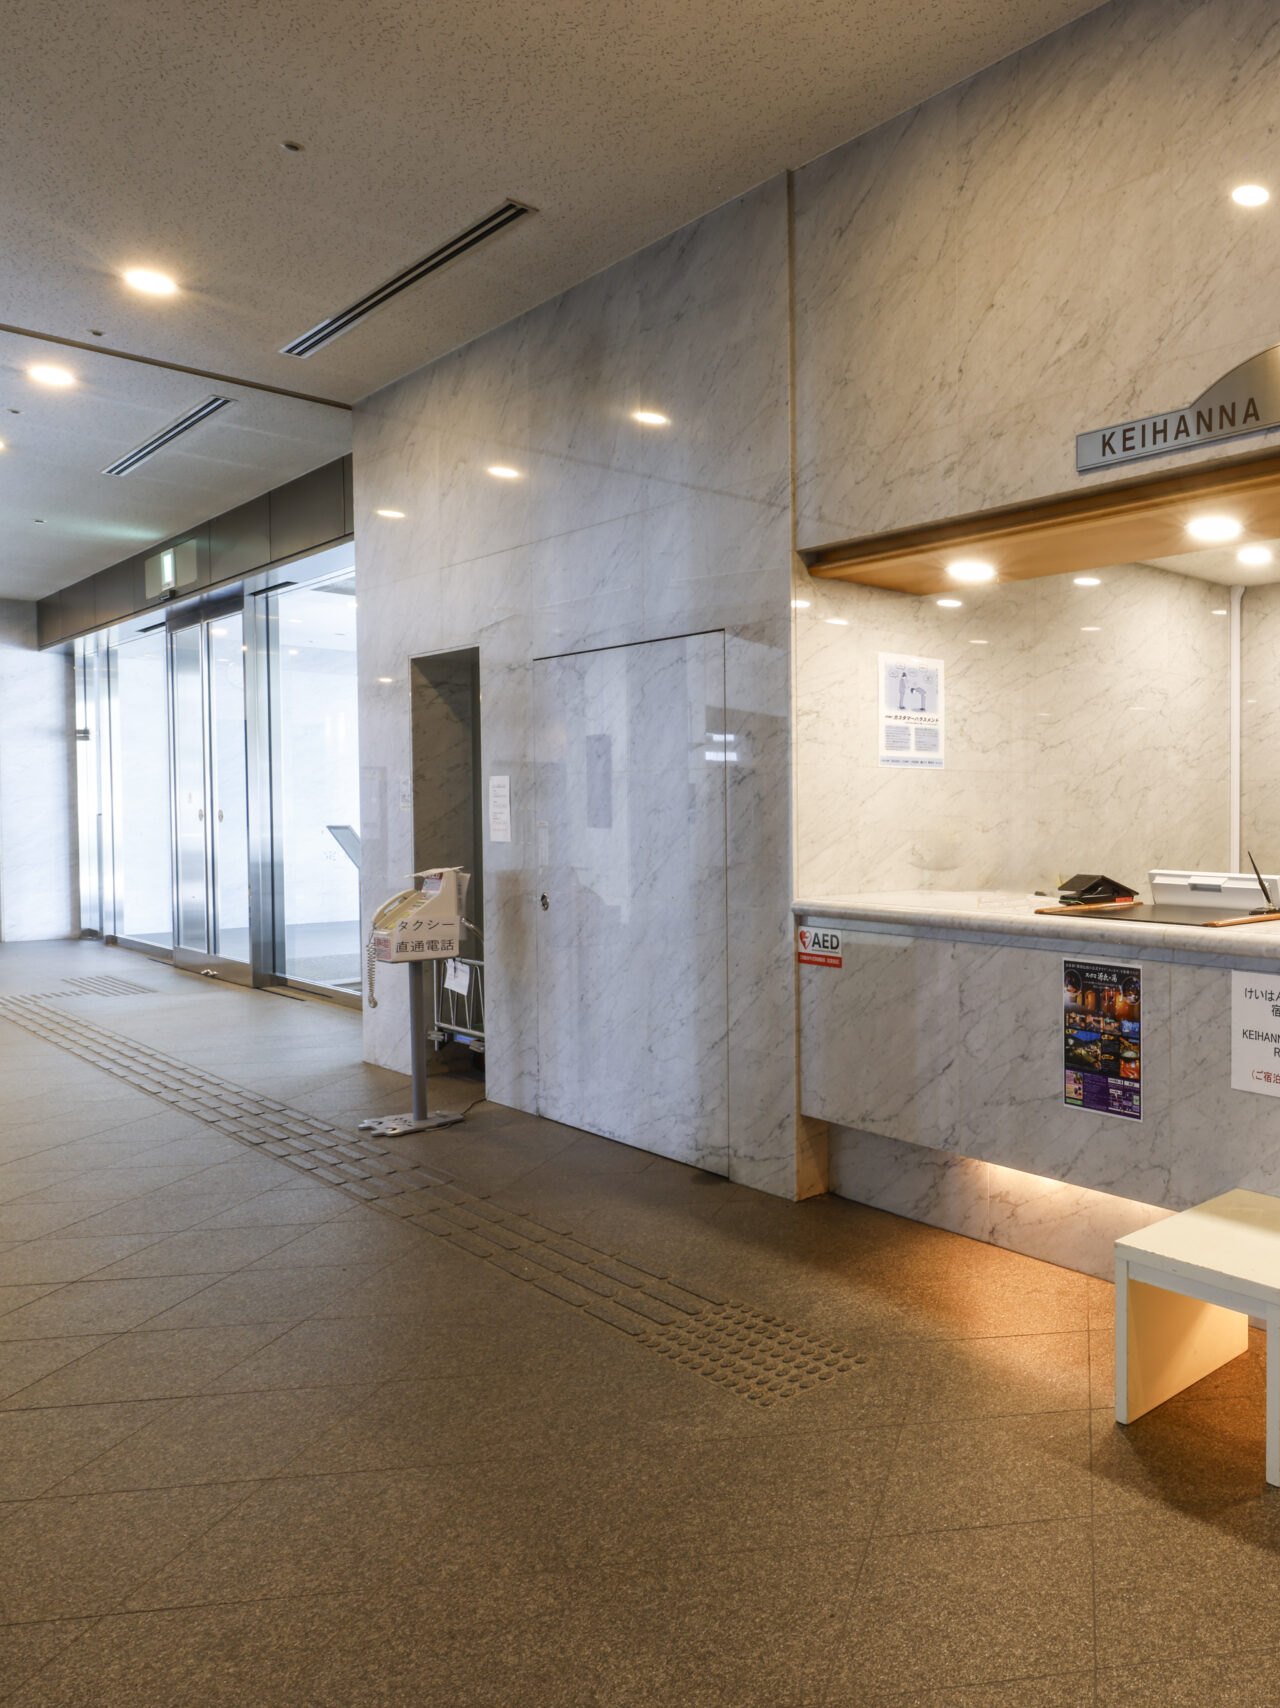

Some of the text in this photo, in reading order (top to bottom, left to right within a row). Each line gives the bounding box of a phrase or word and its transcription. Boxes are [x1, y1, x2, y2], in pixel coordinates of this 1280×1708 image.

[1101, 397, 1261, 457] KEIHANNA
[398, 919, 455, 932] タクシー
[396, 938, 455, 953] 直通電話
[811, 932, 840, 950] AED
